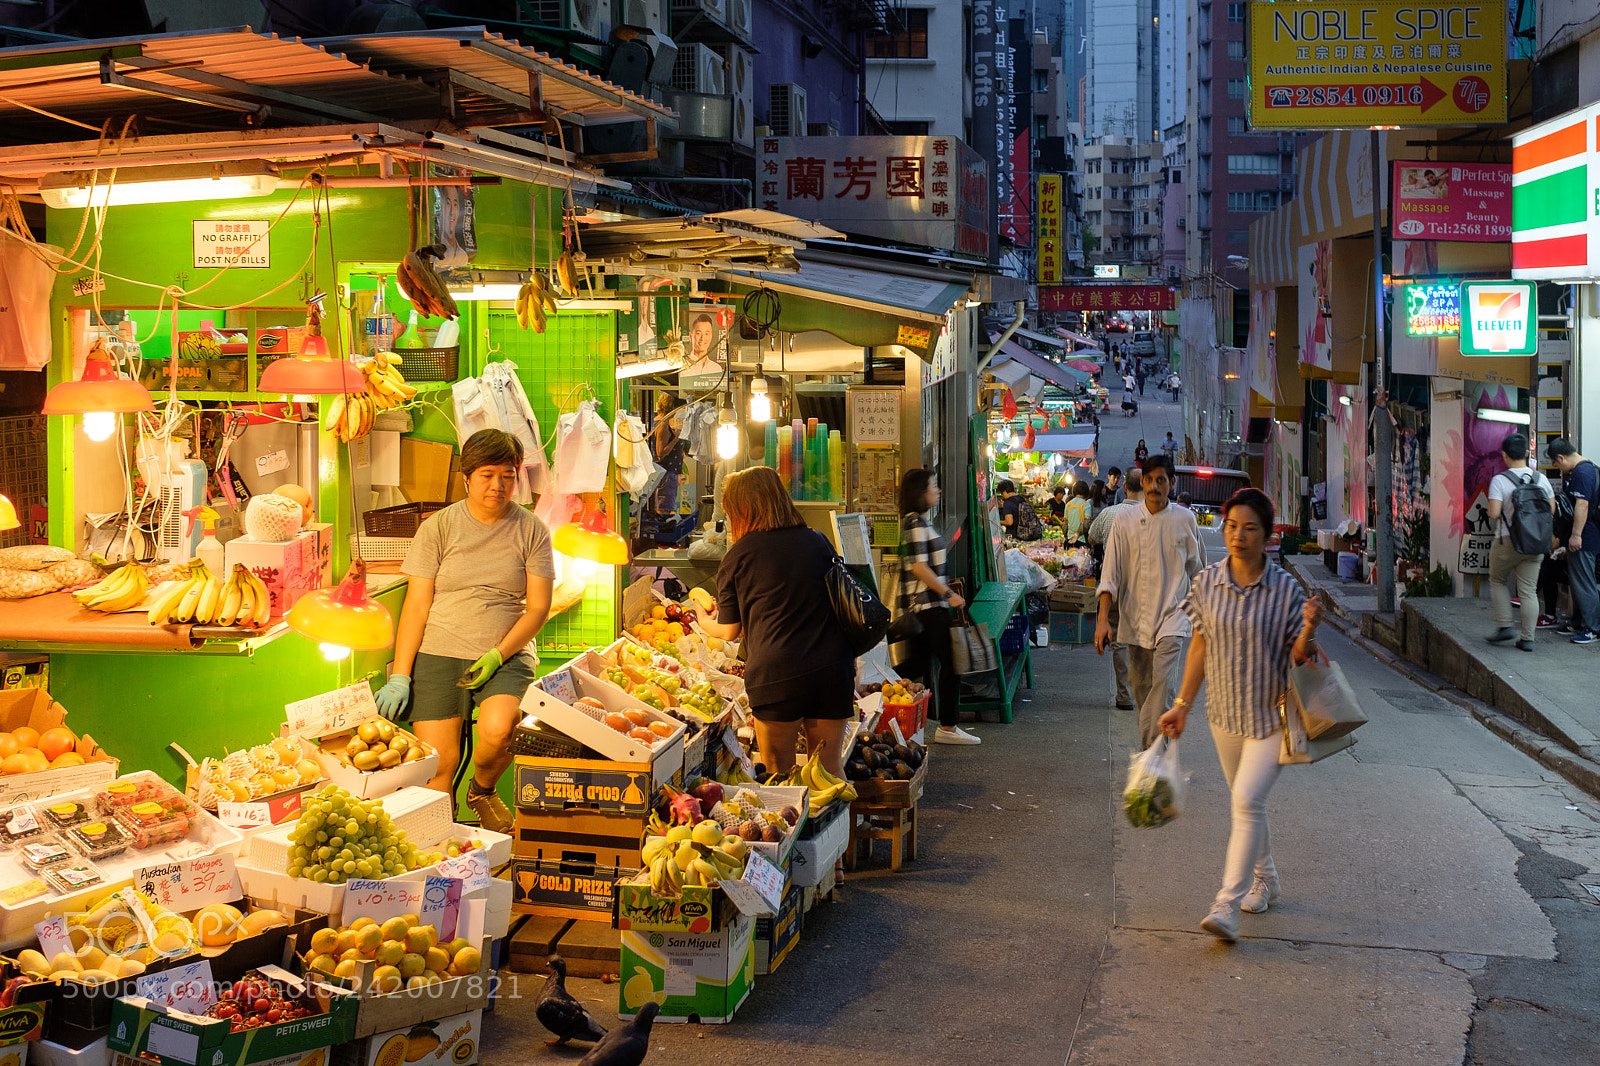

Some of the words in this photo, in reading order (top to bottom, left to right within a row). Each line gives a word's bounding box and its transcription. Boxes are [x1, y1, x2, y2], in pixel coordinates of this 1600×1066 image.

[1273, 9, 1379, 42] NOBLE
[1394, 7, 1482, 41] SPICE
[1296, 43, 1462, 61] 正宗印度及尼泊爾菜
[1265, 62, 1327, 75] Authentic
[1329, 62, 1369, 74] Indian
[1372, 62, 1381, 74] &
[1383, 62, 1442, 75] Nepalese
[1445, 61, 1493, 73] Cuisine
[974, 51, 992, 107] Lofts
[1296, 86, 1357, 105] 2854
[1363, 85, 1423, 104] 0916
[1458, 80, 1488, 110] 7/F
[785, 156, 925, 201] 蘭芳園
[1462, 169, 1496, 183] Perfect
[1462, 187, 1505, 199] Massage
[1401, 202, 1450, 213] Massage
[1478, 201, 1488, 209] &
[1466, 212, 1500, 223] Beauty
[1427, 222, 1481, 235] Tel:2568
[1484, 223, 1513, 235] 1899
[202, 234, 217, 242] NO
[219, 234, 261, 242] GRAFFITI
[198, 256, 222, 264] POST
[224, 256, 239, 264] NO
[241, 256, 266, 264] BILLS
[1052, 290, 1161, 307] 中信藥業公司
[1468, 539, 1492, 550] End
[545, 783, 584, 799] PRIZE
[586, 785, 620, 801] GOLD
[539, 874, 571, 892] GOLD
[574, 877, 612, 896] PRIZE
[668, 937, 686, 947] San
[687, 938, 721, 950] Miguel
[157, 1016, 173, 1027] PETIT
[172, 1020, 193, 1033] SWEET
[276, 1023, 301, 1037] PETIT
[301, 1016, 332, 1031] SWEET
